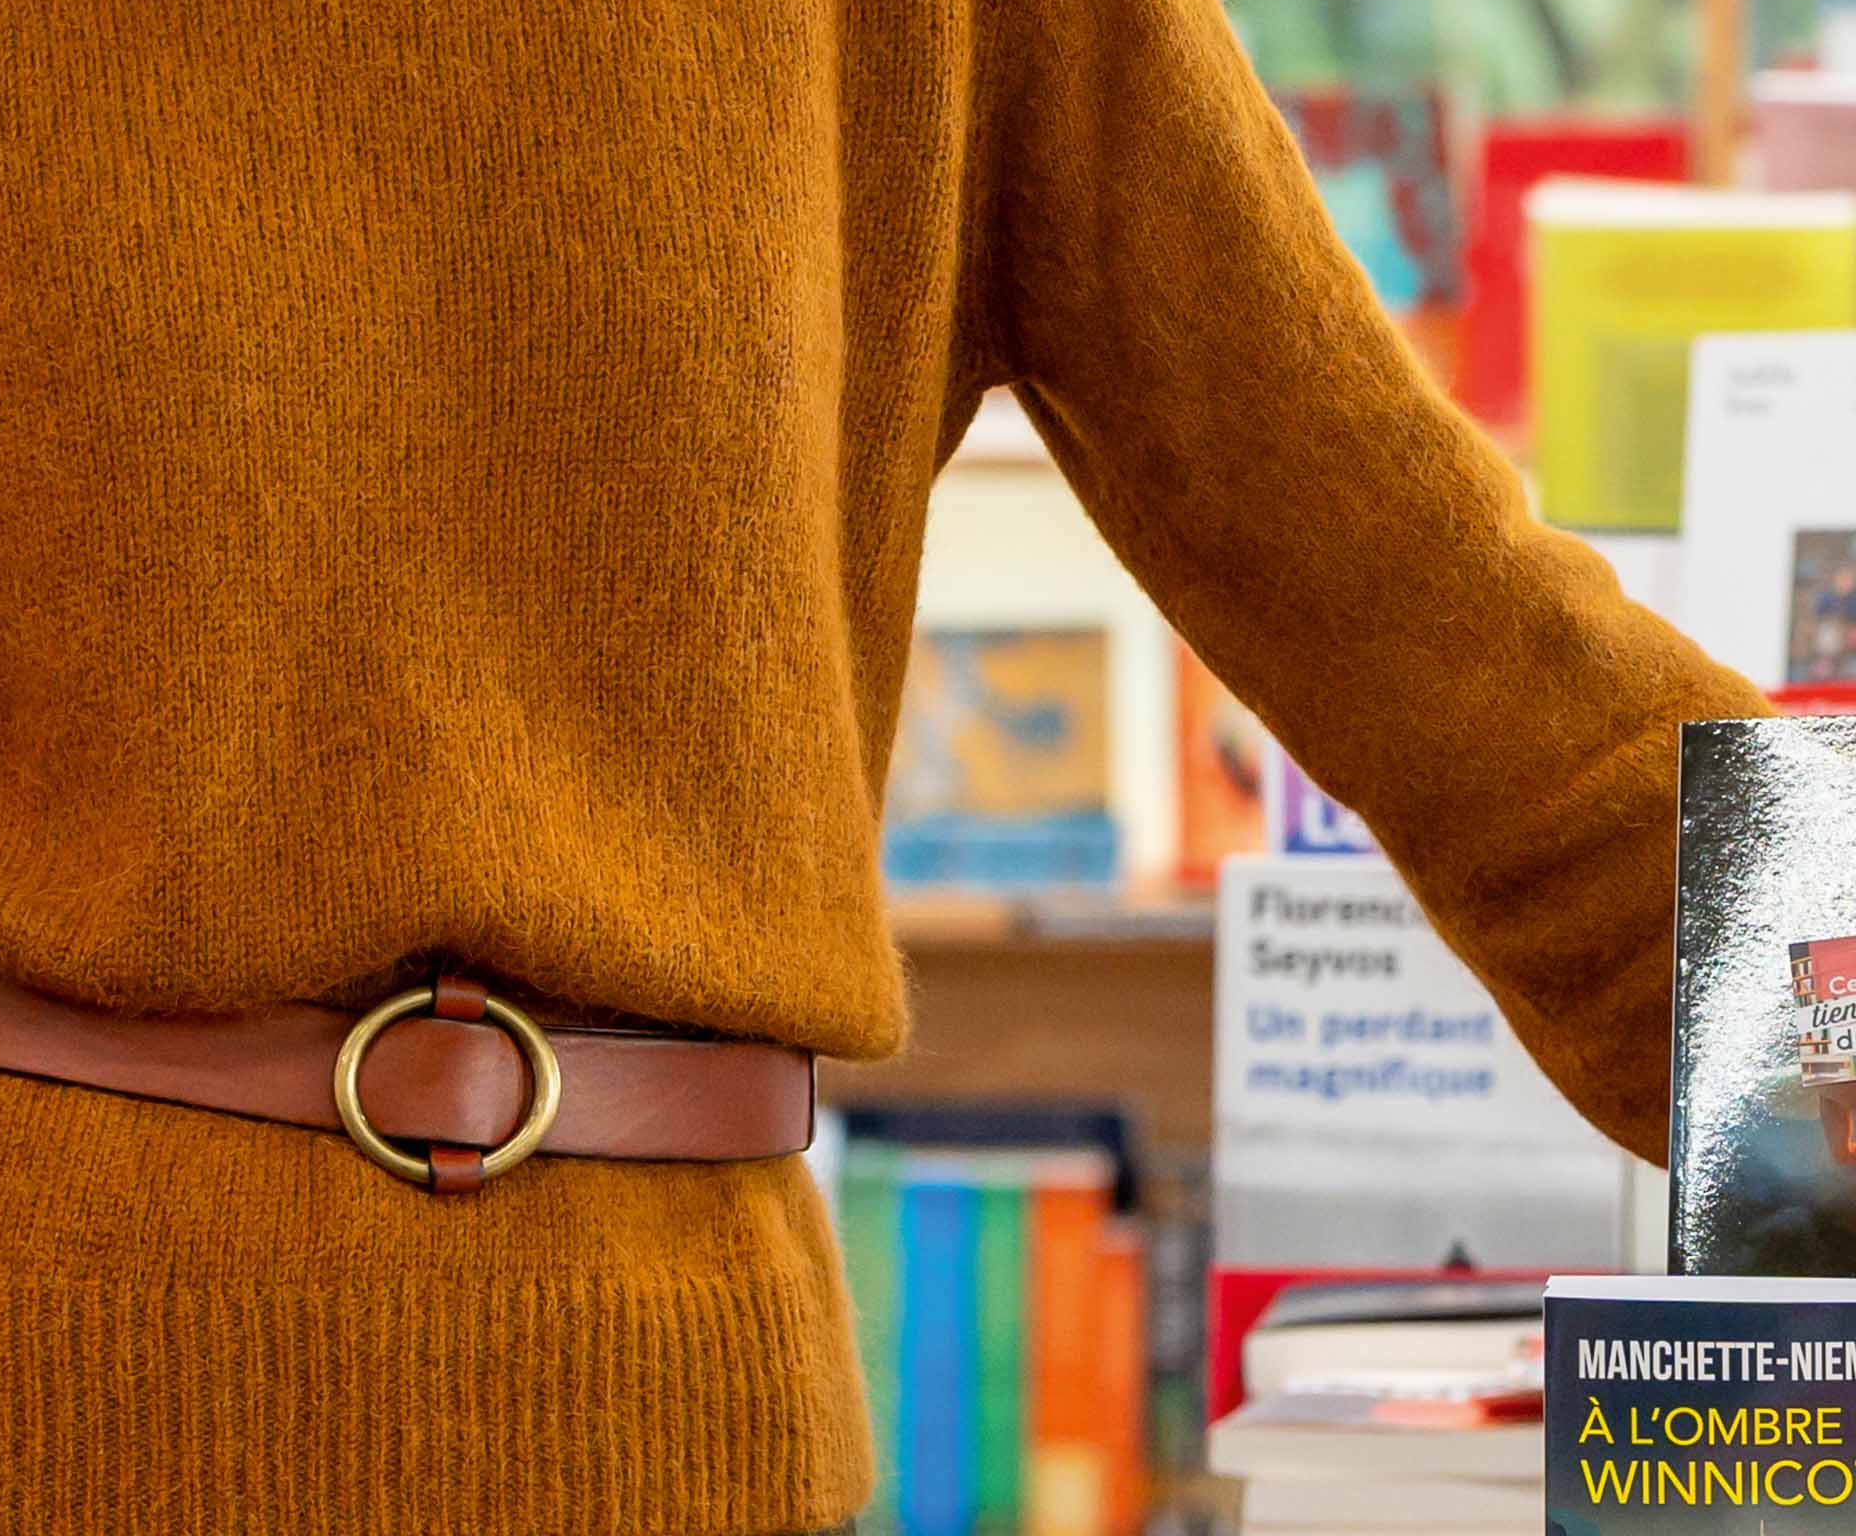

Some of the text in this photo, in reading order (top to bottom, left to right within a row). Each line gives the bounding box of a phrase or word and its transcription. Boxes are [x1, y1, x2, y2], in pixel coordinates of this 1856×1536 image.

[1251, 884, 1426, 928] Florenc
[1249, 940, 1399, 985] Seyvos
[1248, 1005, 1495, 1051] Un perdant
[1247, 1060, 1495, 1104] magnifique
[1578, 1396, 1614, 1445] À
[1631, 1407, 1842, 1445] L'OMBRE
